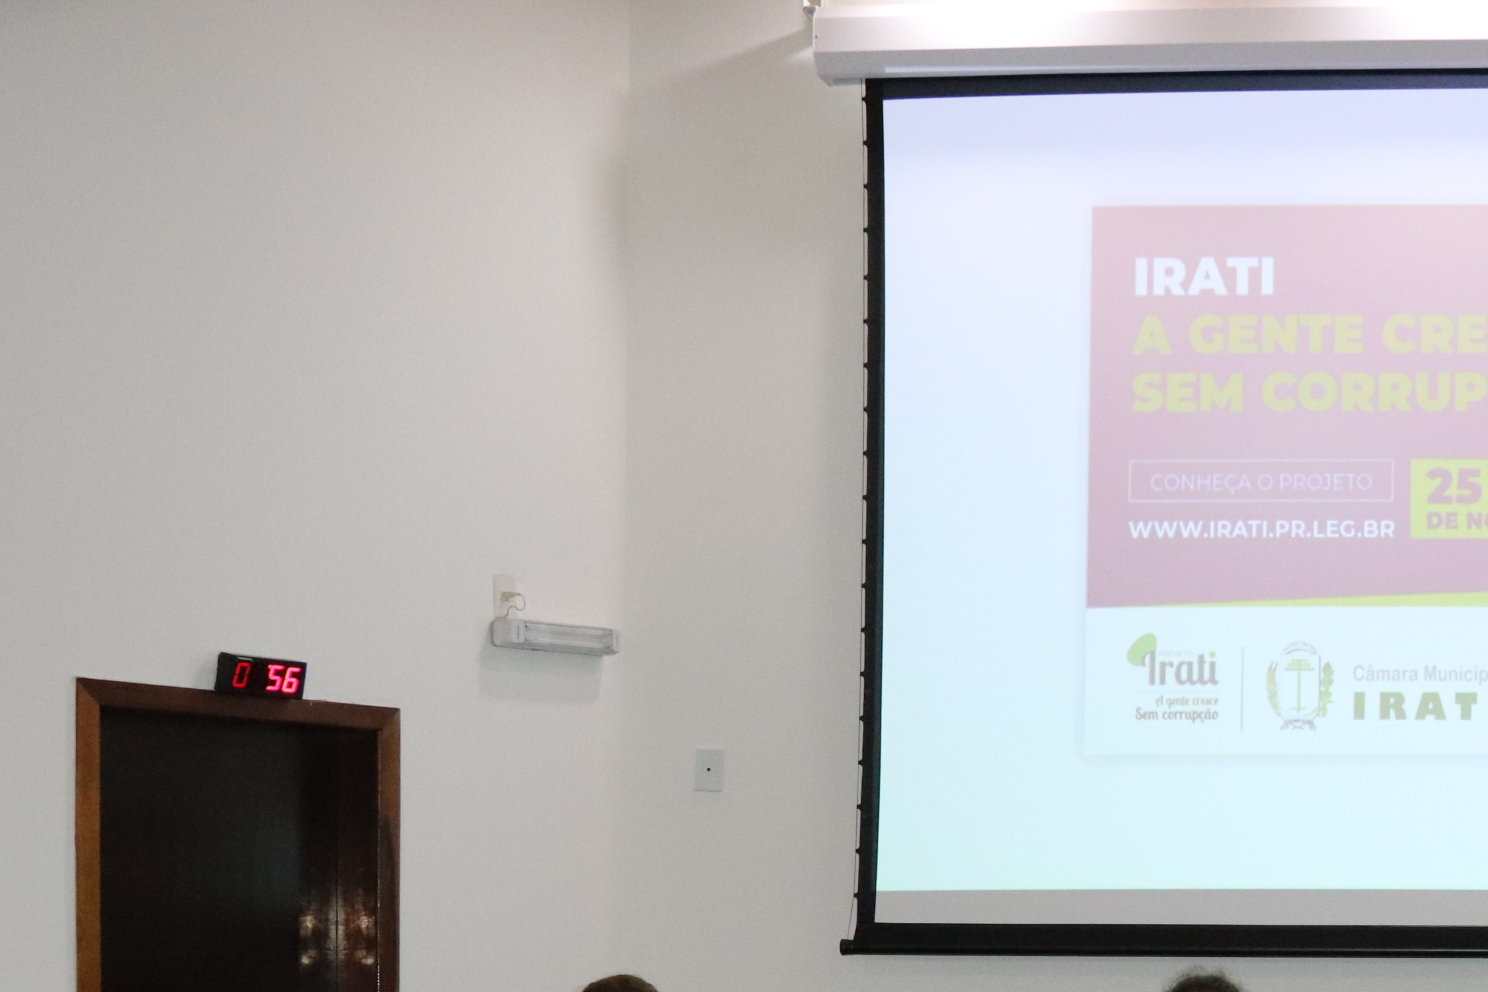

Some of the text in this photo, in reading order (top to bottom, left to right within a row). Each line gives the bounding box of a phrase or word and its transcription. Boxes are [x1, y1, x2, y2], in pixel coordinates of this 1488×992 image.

[1134, 256, 1274, 296] IRATI
[1131, 315, 1172, 354] A
[1188, 314, 1365, 354] GENTE
[1131, 371, 1245, 412] SEM
[1150, 472, 1373, 495] CONHEÇA O PROJETO
[1426, 467, 1482, 505] 25
[1129, 519, 1394, 539] WWW.IRATI.PR.LEG.BR
[1426, 512, 1458, 530] DE
[232, 661, 302, 694] 0 56
[1141, 649, 1219, 686] Irati
[1353, 664, 1418, 682] Câmara
[1135, 706, 1219, 723] Sem corrupção
